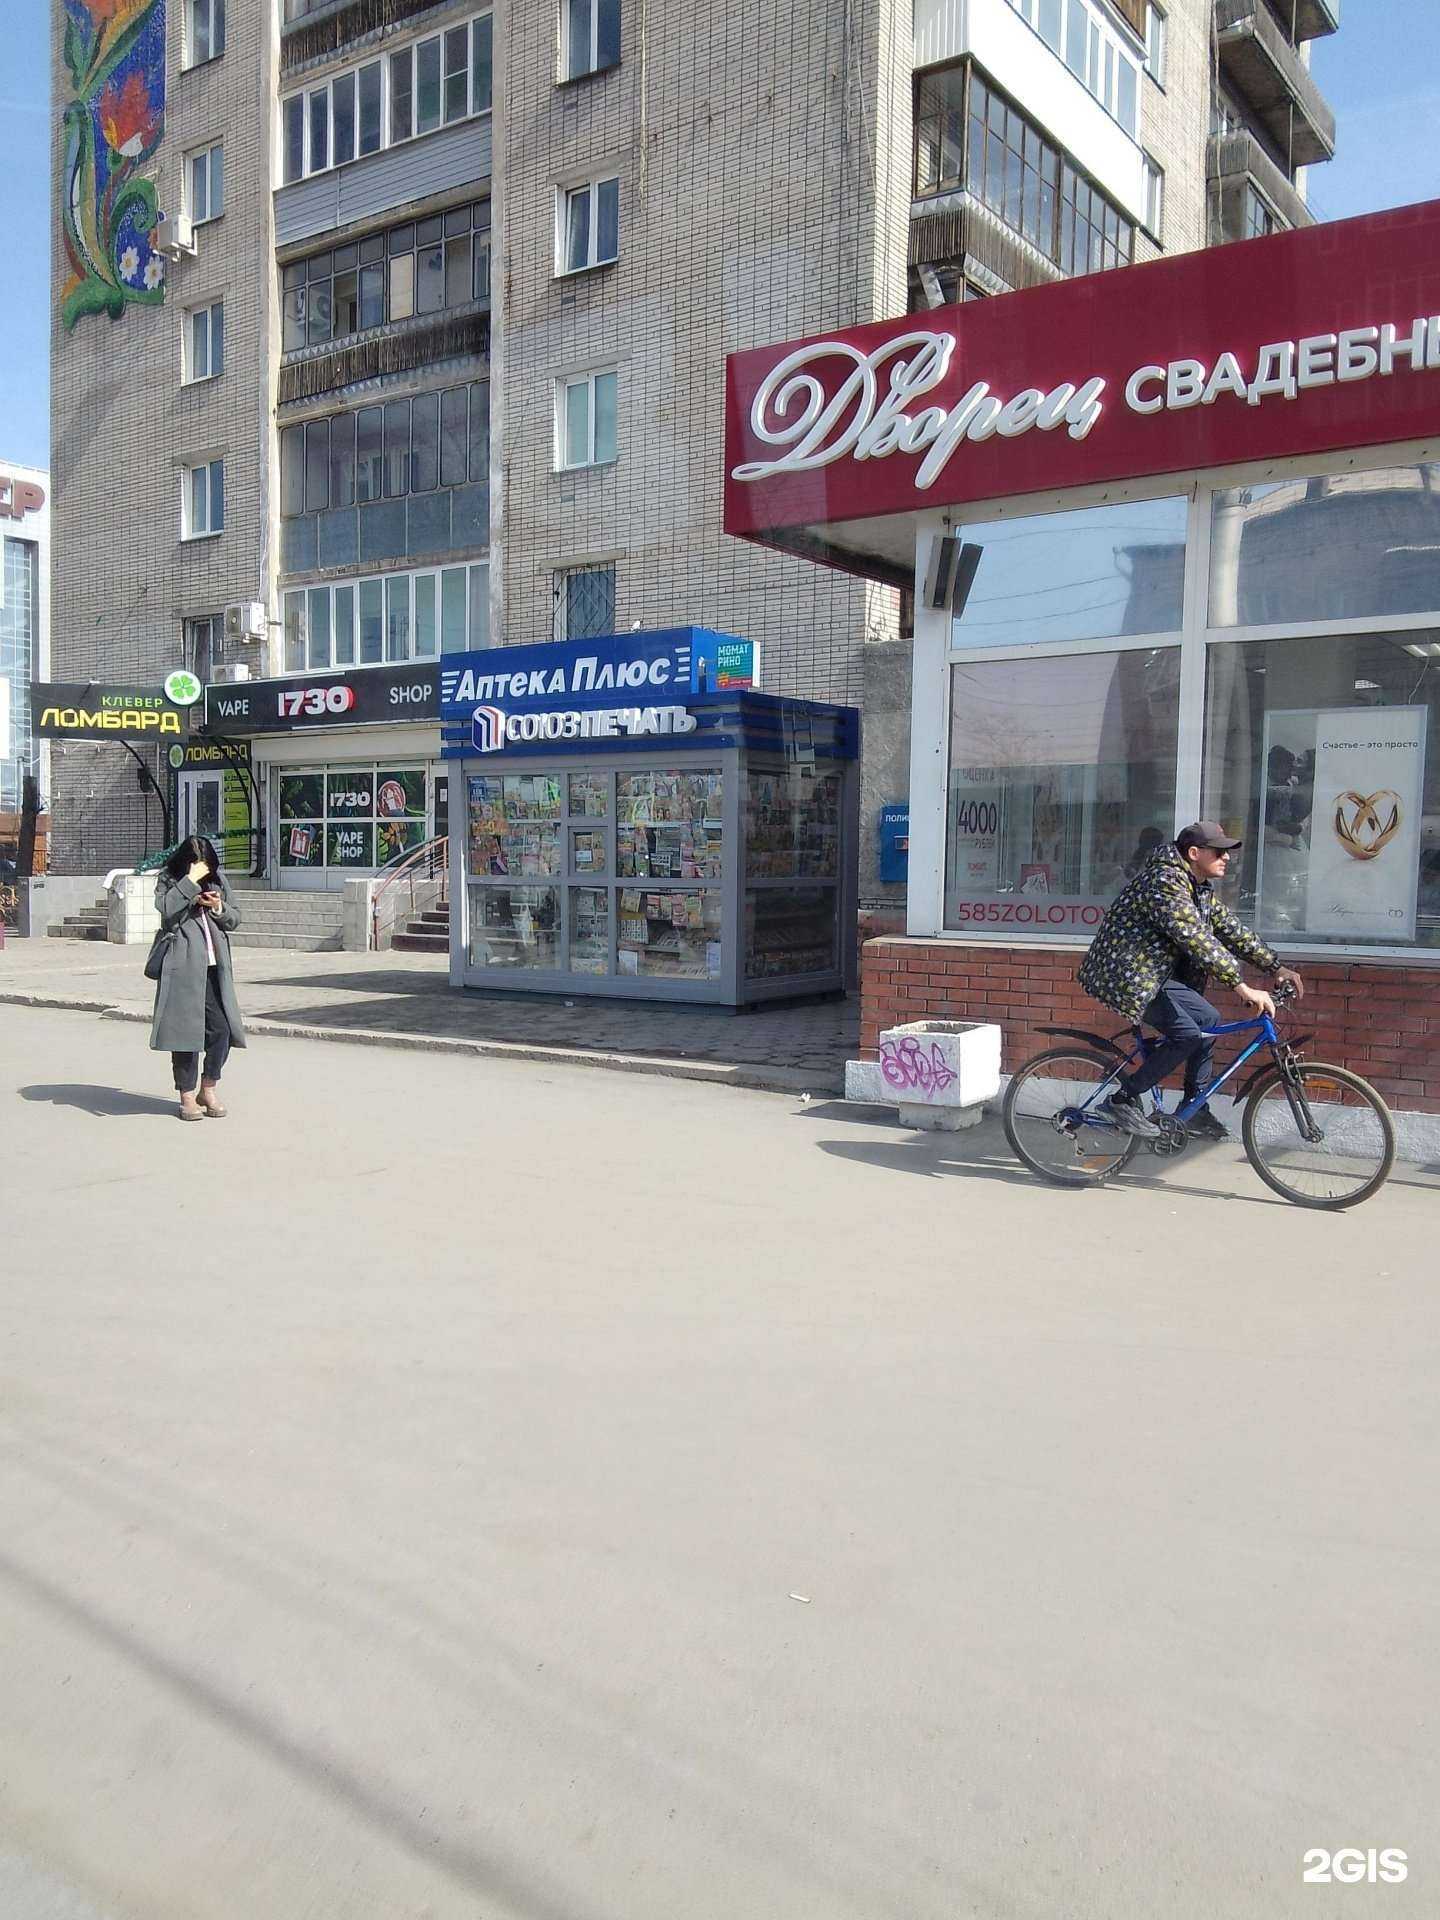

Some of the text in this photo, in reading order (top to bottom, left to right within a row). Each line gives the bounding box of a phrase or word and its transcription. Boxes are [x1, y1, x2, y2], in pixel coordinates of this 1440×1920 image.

[731, 315, 1440, 489] Дворец СВАДЕБН
[102, 696, 163, 708] КЛЕВЕР
[217, 684, 432, 717] VAPE 1730 SHOP
[40, 708, 181, 734] ЛОМБАРД
[506, 705, 697, 741] СОЮЗПЕЧАТЬ
[1385, 741, 1419, 750] просто
[329, 791, 371, 807] 1730
[958, 800, 998, 834] 4000
[336, 831, 364, 844] VAPE
[336, 846, 363, 858] SHOP
